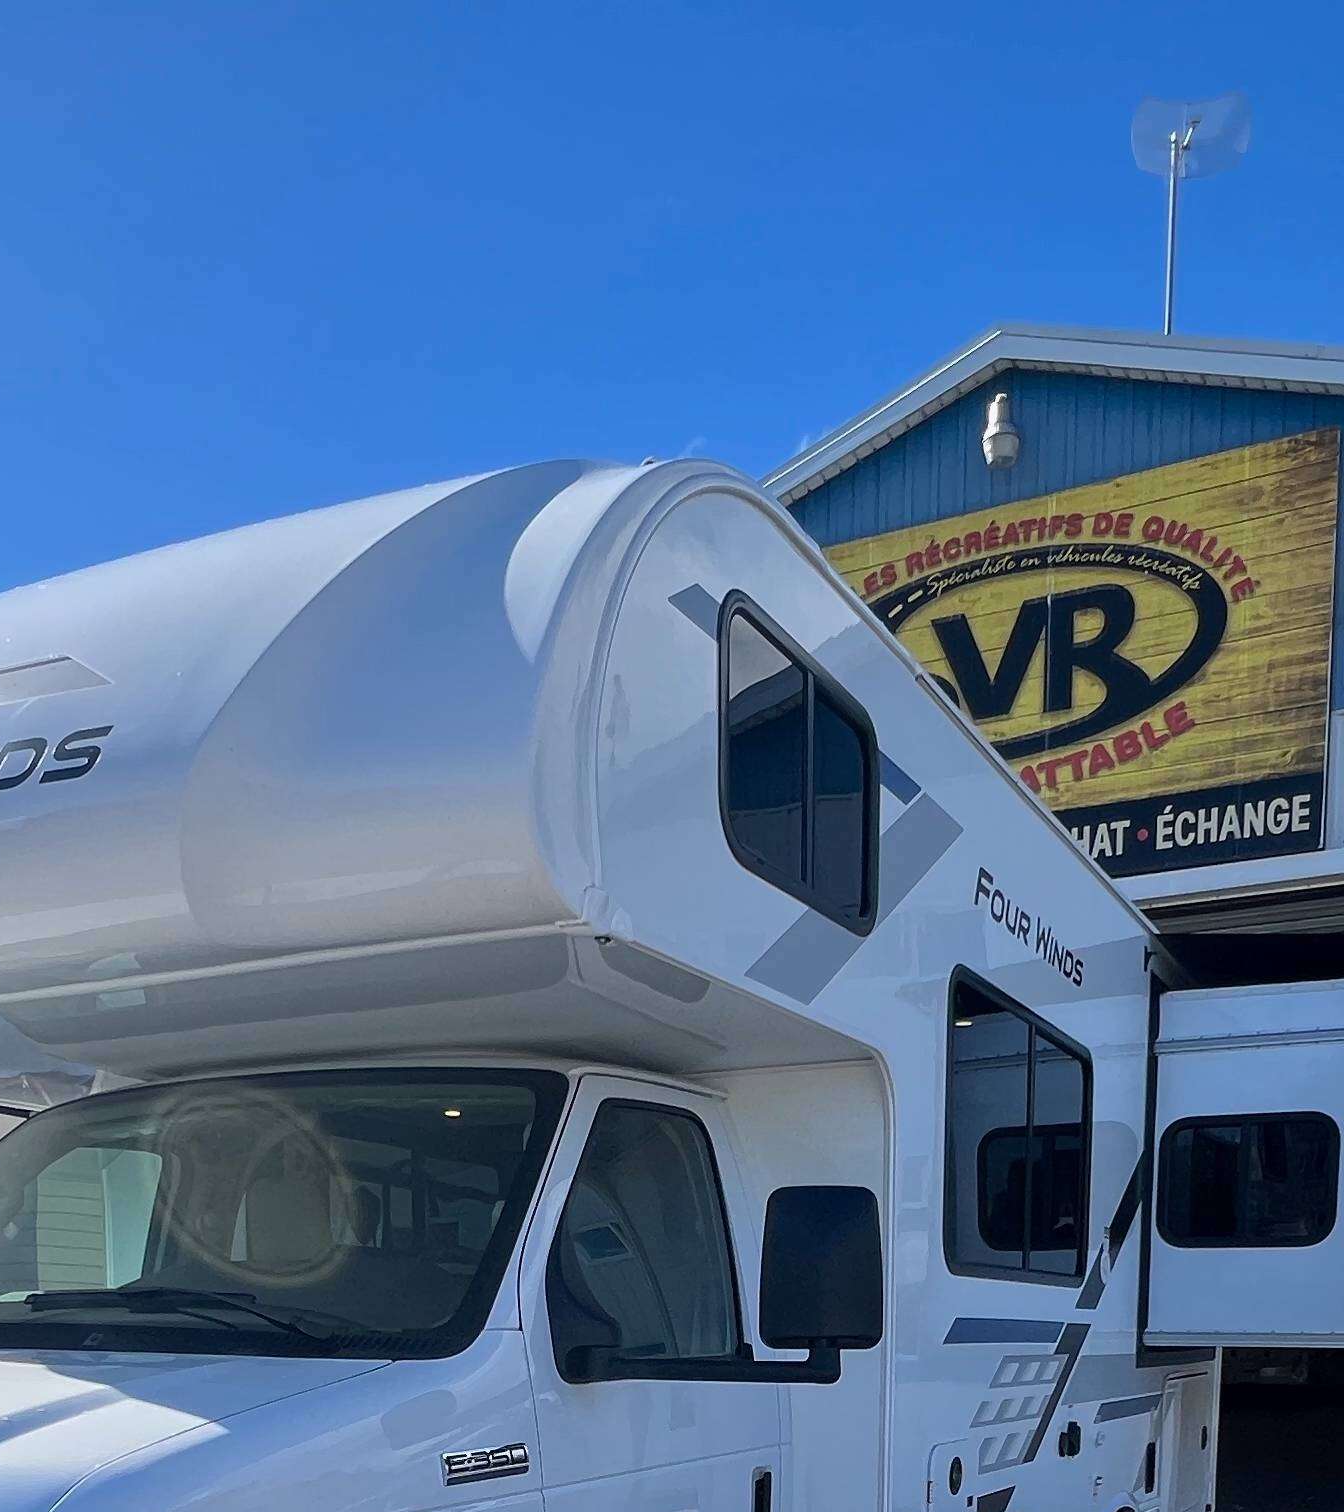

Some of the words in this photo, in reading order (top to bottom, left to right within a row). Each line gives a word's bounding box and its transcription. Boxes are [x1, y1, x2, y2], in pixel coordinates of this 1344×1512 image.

[860, 563, 897, 599] ES
[906, 512, 1084, 577] RÉCRÉATIFS
[1092, 512, 1134, 538] DE
[1142, 515, 1261, 603] QUALITÉ
[927, 557, 1016, 597] Spécialiste
[1020, 556, 1041, 568] en
[1047, 545, 1124, 565] véhicules
[1127, 553, 1201, 590] récréatifs
[931, 583, 1152, 721] VR
[1156, 794, 1311, 850] ÉCHANGE
[973, 866, 1032, 946] FOUR
[1035, 916, 1085, 987] WINDS
